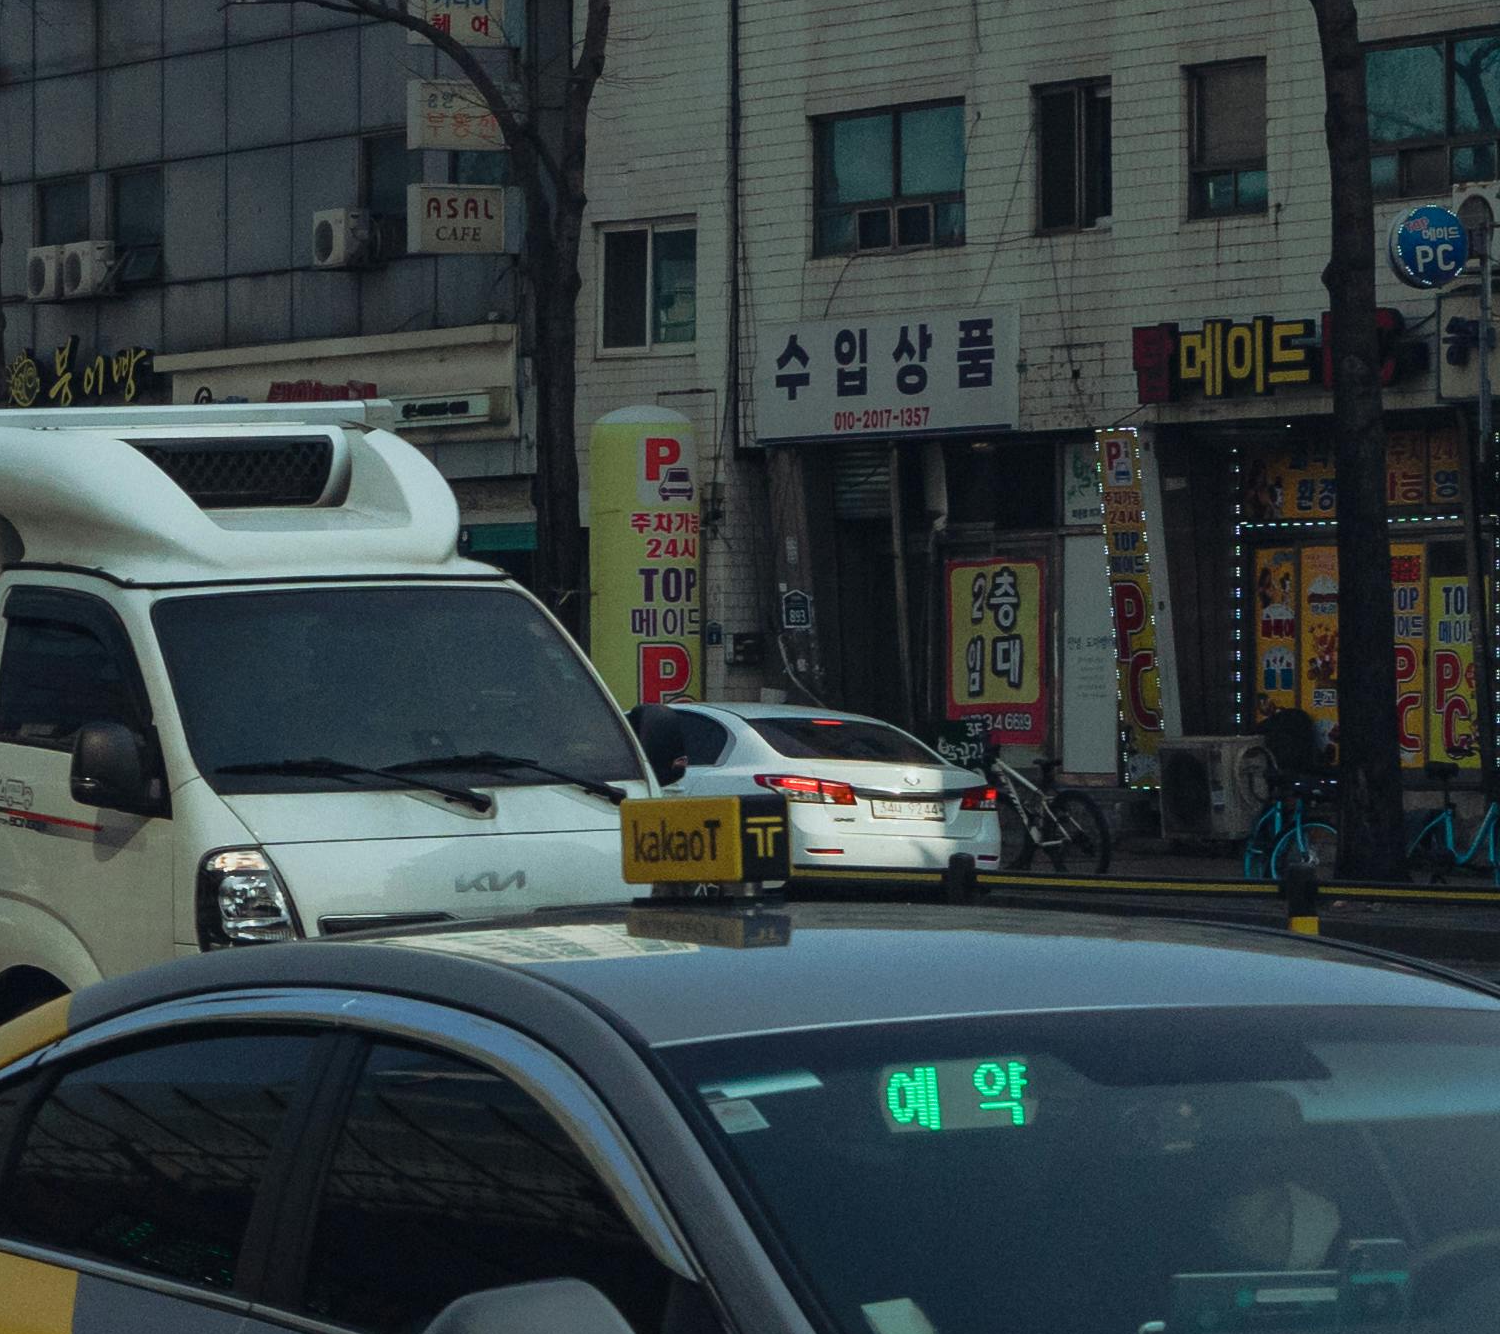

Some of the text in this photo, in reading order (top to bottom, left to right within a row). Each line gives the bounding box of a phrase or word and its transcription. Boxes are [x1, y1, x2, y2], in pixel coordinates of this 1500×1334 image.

[427, 197, 494, 220] ASAL
[435, 226, 482, 242] CAFE
[1415, 244, 1456, 273] PC
[776, 317, 995, 401] 수입상품
[1180, 319, 1310, 396] 메이드
[834, 407, 930, 431] 010-2017-1357
[645, 437, 681, 482] P
[646, 538, 696, 559] 24시
[1112, 531, 1140, 551] TOP
[638, 567, 697, 603] TOP
[971, 566, 1020, 633] 2층
[631, 608, 700, 637] 메이드
[967, 634, 1024, 698] 임대
[886, 1061, 1030, 1133] 예약
